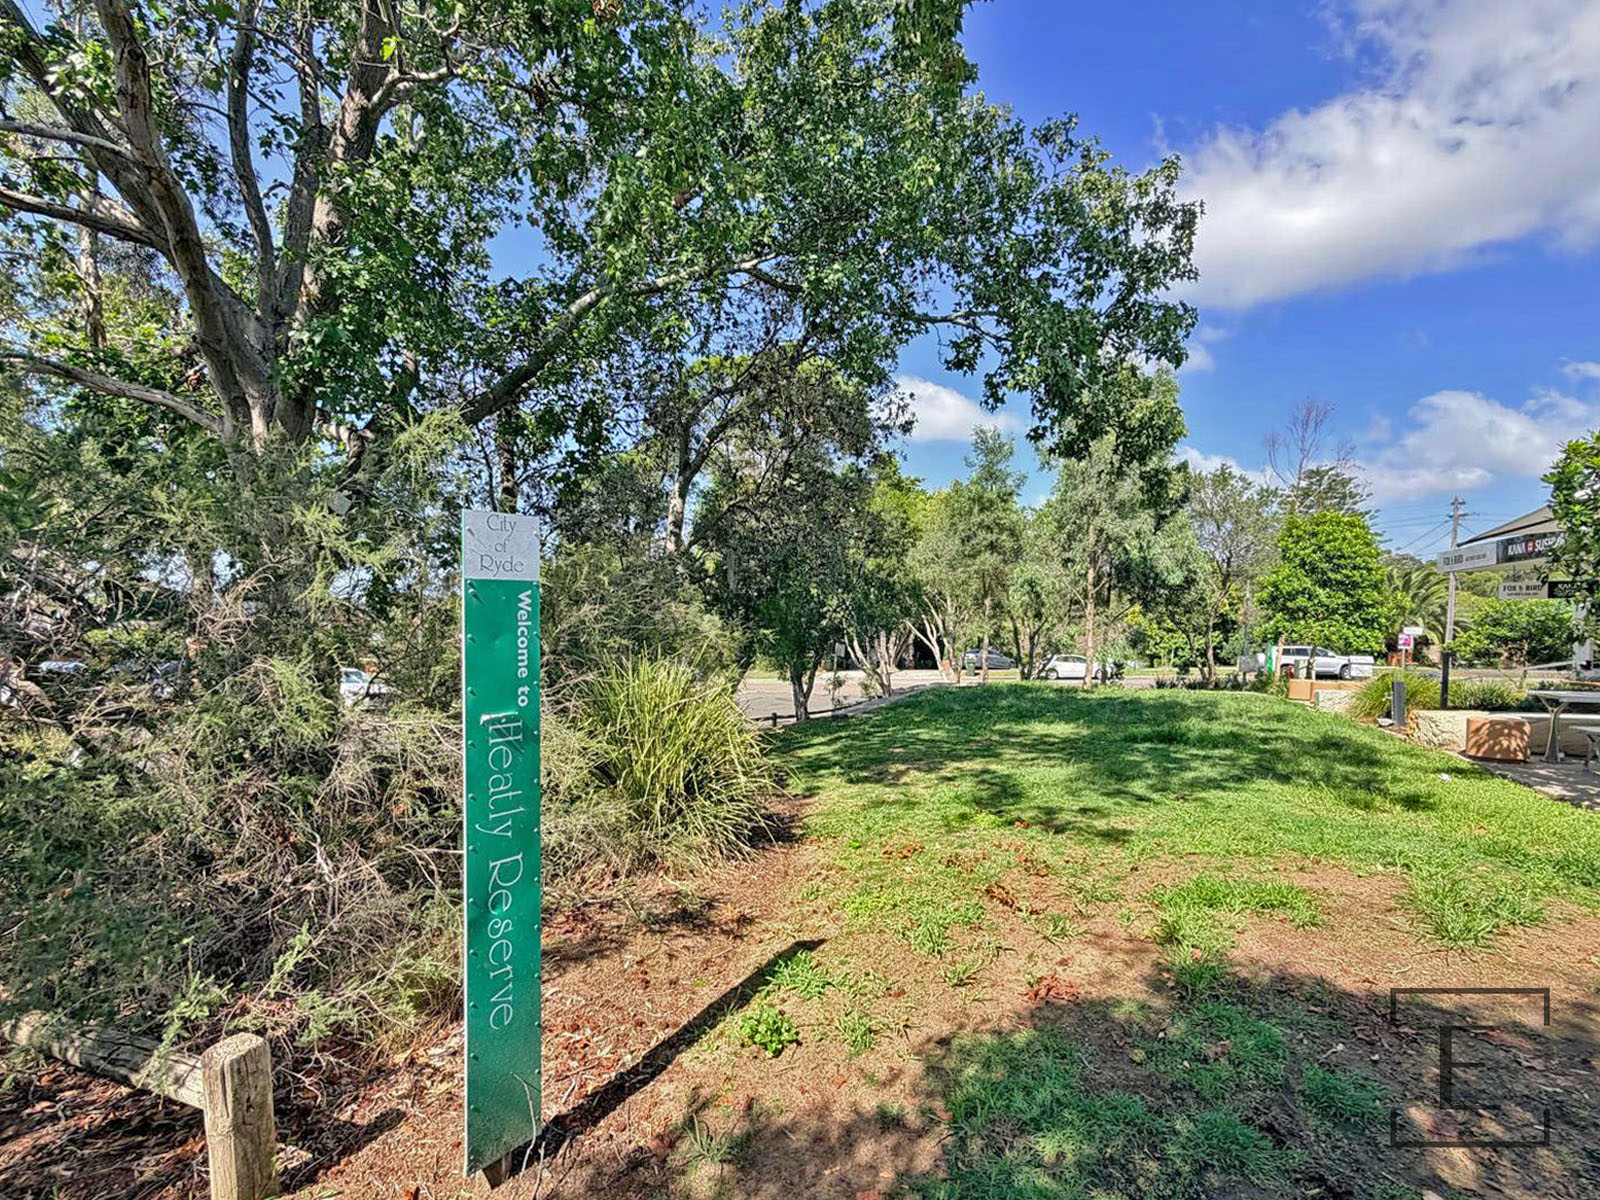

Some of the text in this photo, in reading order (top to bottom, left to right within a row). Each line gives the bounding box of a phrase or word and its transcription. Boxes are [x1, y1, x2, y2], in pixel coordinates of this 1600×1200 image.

[486, 514, 517, 538] City
[494, 539, 510, 553] of
[480, 554, 524, 578] Ryde
[517, 589, 532, 707] Welcome to
[475, 719, 527, 1030] Heatly Reserve
